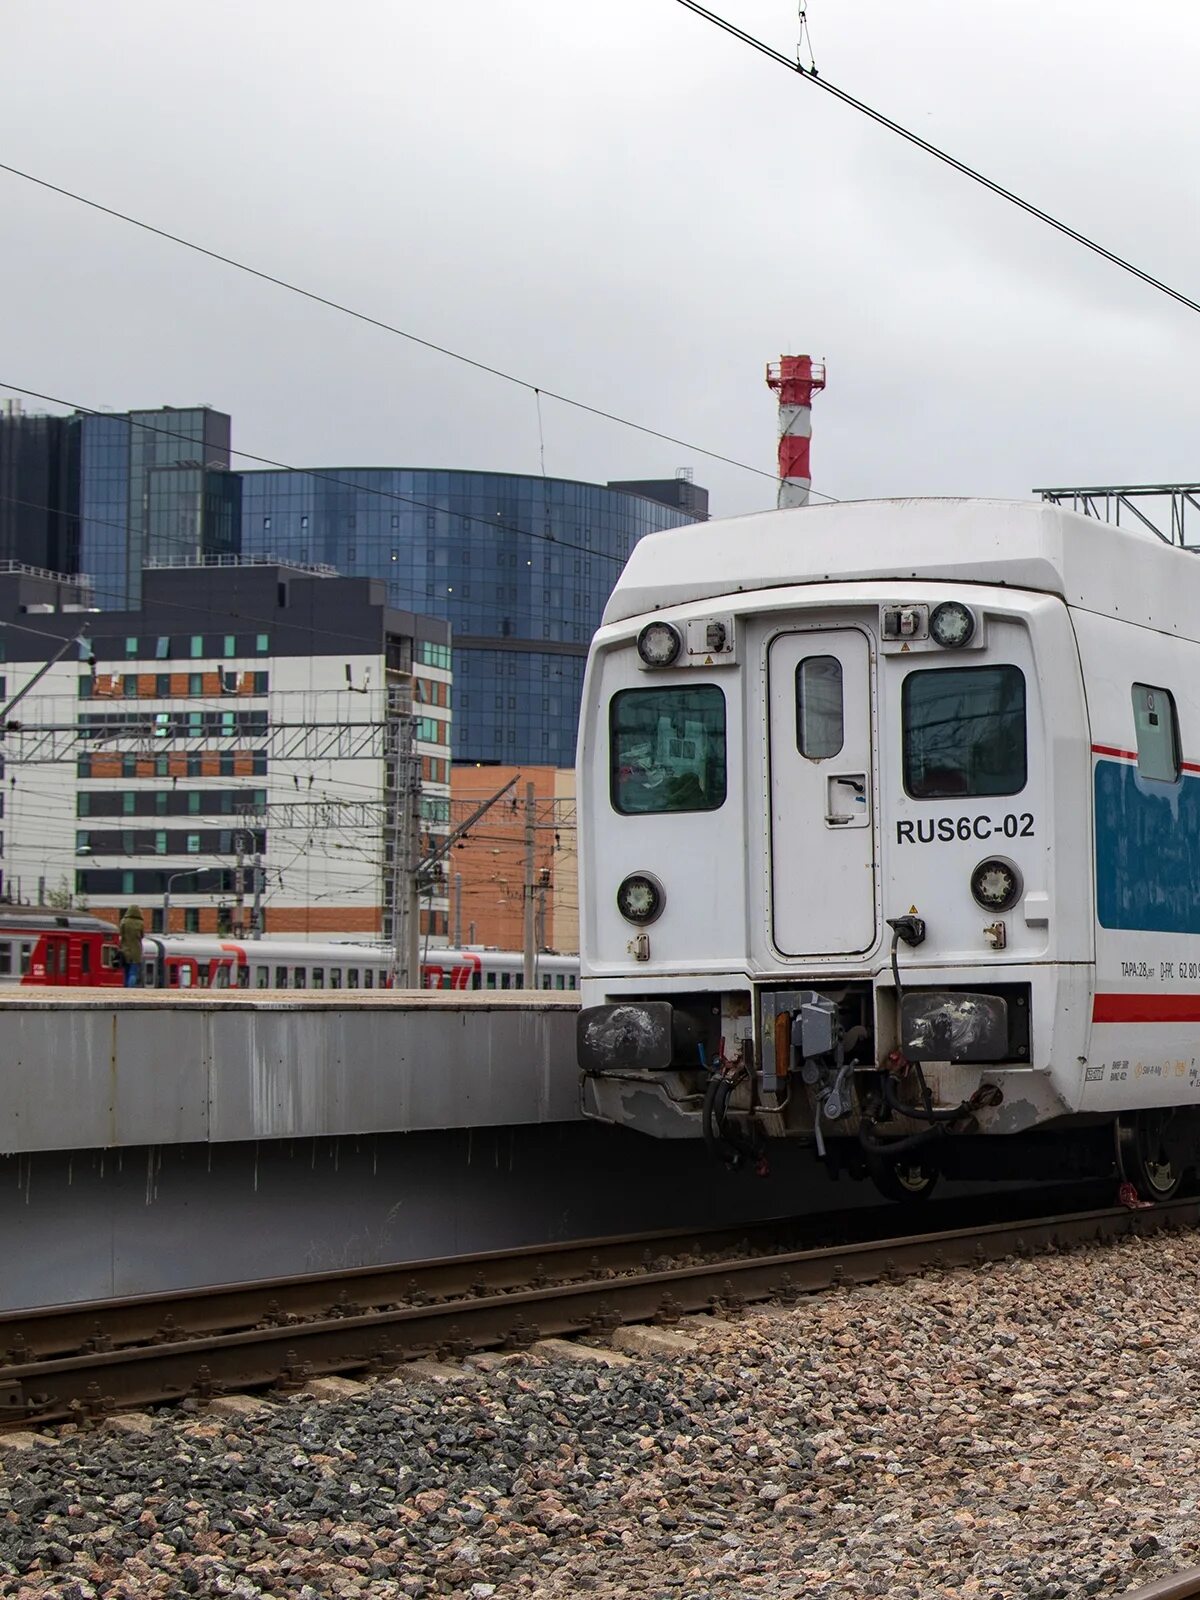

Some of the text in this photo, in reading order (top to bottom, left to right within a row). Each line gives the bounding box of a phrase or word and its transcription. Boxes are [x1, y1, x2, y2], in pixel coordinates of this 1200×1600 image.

[896, 813, 1035, 845] RUS6C-02
[1179, 962, 1187, 979] 62
[1189, 962, 1197, 979] 80
